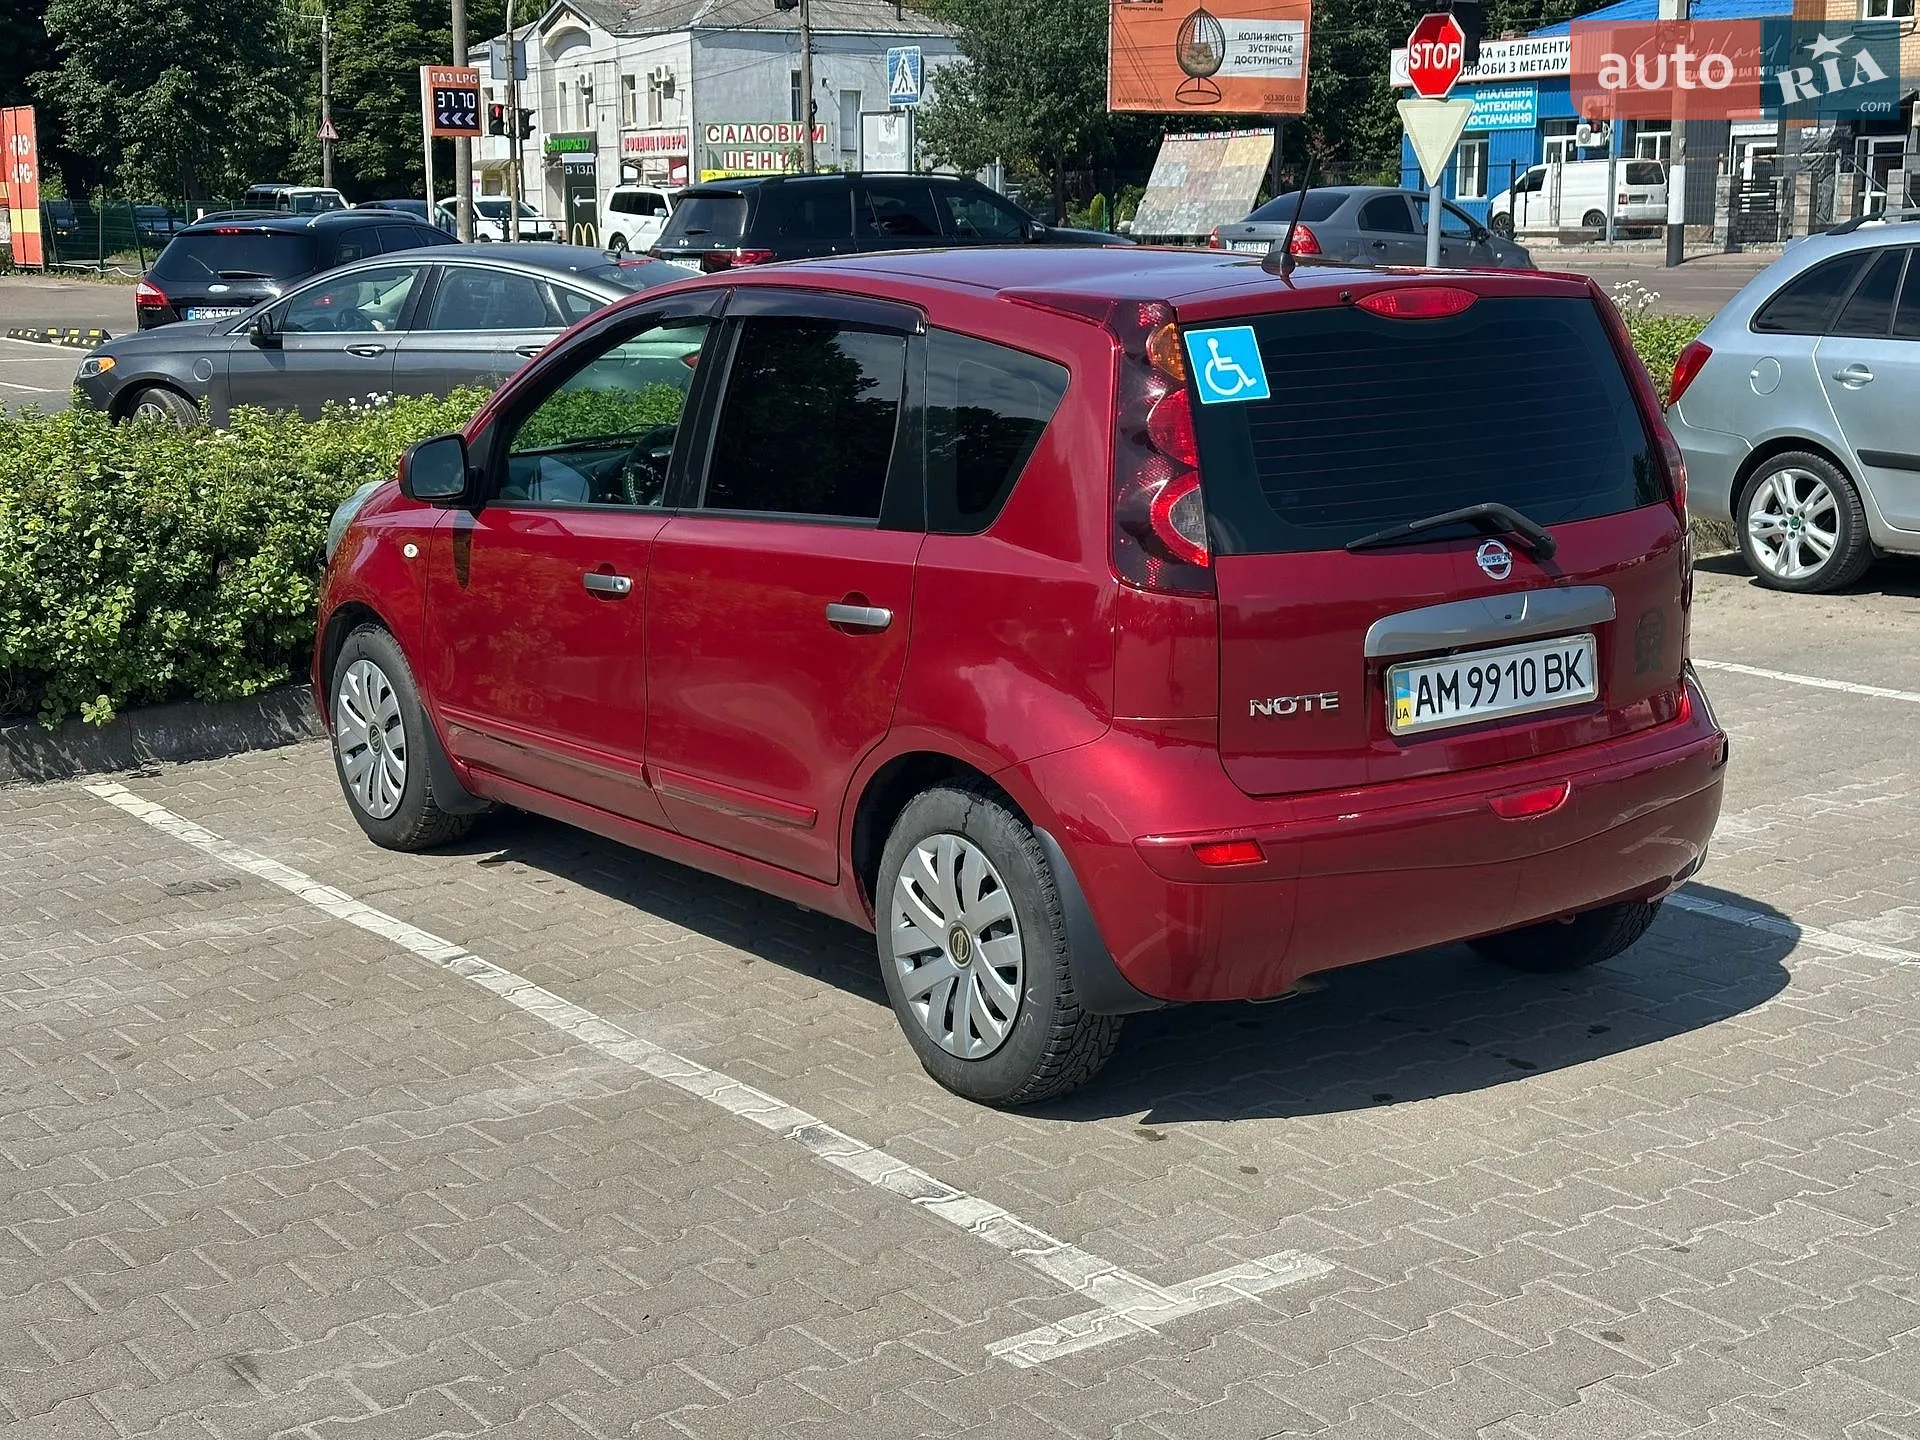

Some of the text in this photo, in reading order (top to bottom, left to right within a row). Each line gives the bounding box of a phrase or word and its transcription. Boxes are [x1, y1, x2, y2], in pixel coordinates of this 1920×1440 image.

[1264, 33, 1294, 42] ЯКІСТЬ
[1248, 44, 1294, 54] ЗУСТРІЧАЄ
[1409, 42, 1461, 70] STOP
[1509, 40, 1573, 57] ЕЛЕМЕНТИ
[1234, 55, 1293, 66] ДОСТУПНІСТЬ
[1519, 57, 1568, 73] МЕТАЛУ
[432, 72, 478, 84] ГАЗ LPG
[437, 91, 476, 109] 37.70
[1475, 87, 1533, 100] ОПАЛЕННЯ
[1473, 99, 1533, 113] АНТЕХНІКА
[13, 162, 31, 184] LPG
[1415, 648, 1586, 717] AM 9910 BK
[1249, 691, 1339, 717] NOTE
[1395, 707, 1410, 720] UA
